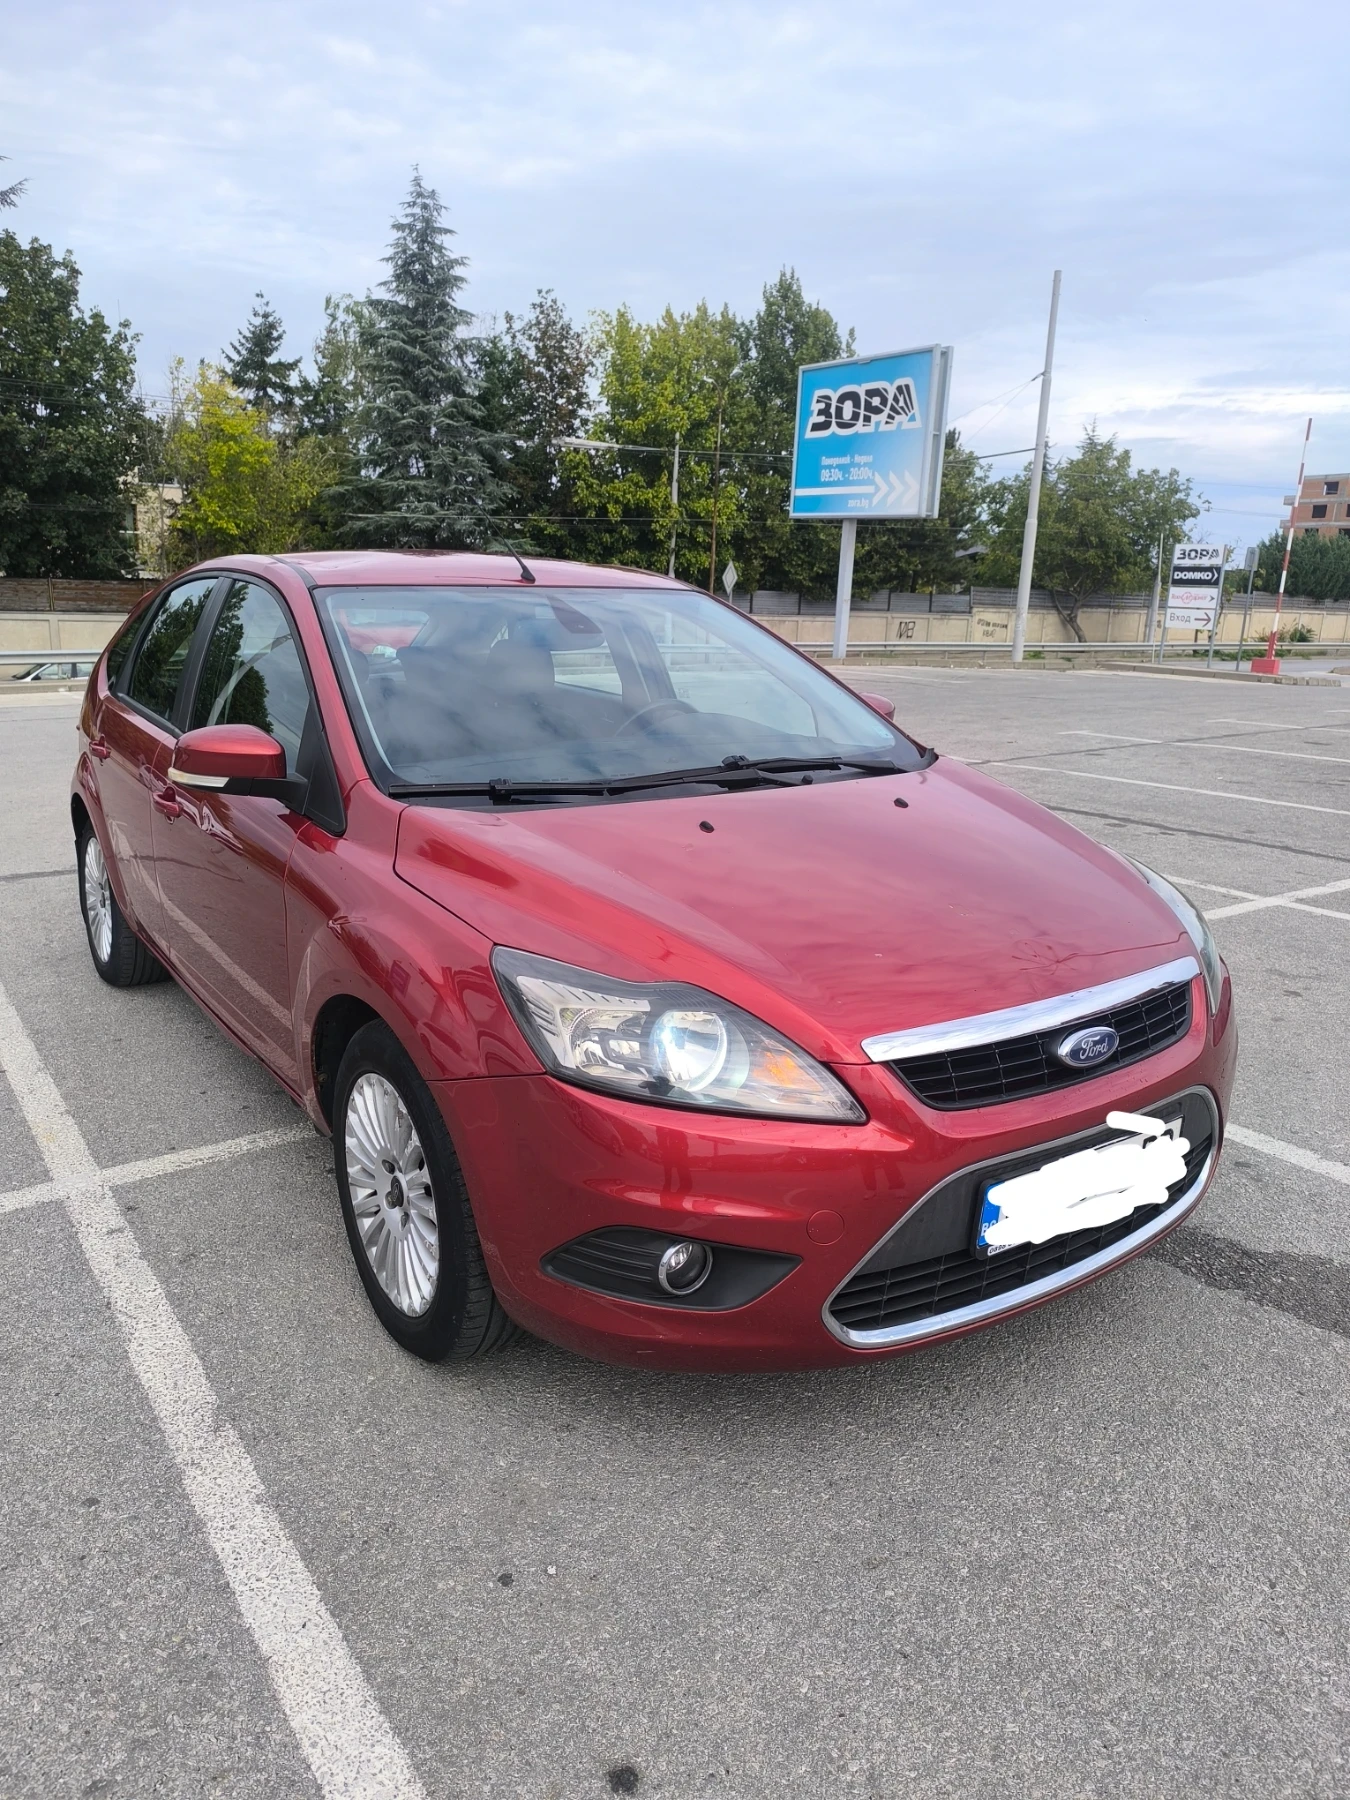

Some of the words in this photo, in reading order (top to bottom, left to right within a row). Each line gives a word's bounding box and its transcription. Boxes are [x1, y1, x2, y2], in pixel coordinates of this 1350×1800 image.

[808, 381, 917, 434] ЗОРА
[847, 497, 869, 508] zora.bg
[1176, 549, 1219, 560] ЗОРА
[1174, 572, 1212, 580] DOMKO
[1169, 613, 1191, 623] Вход
[1079, 1035, 1109, 1060] Ford
